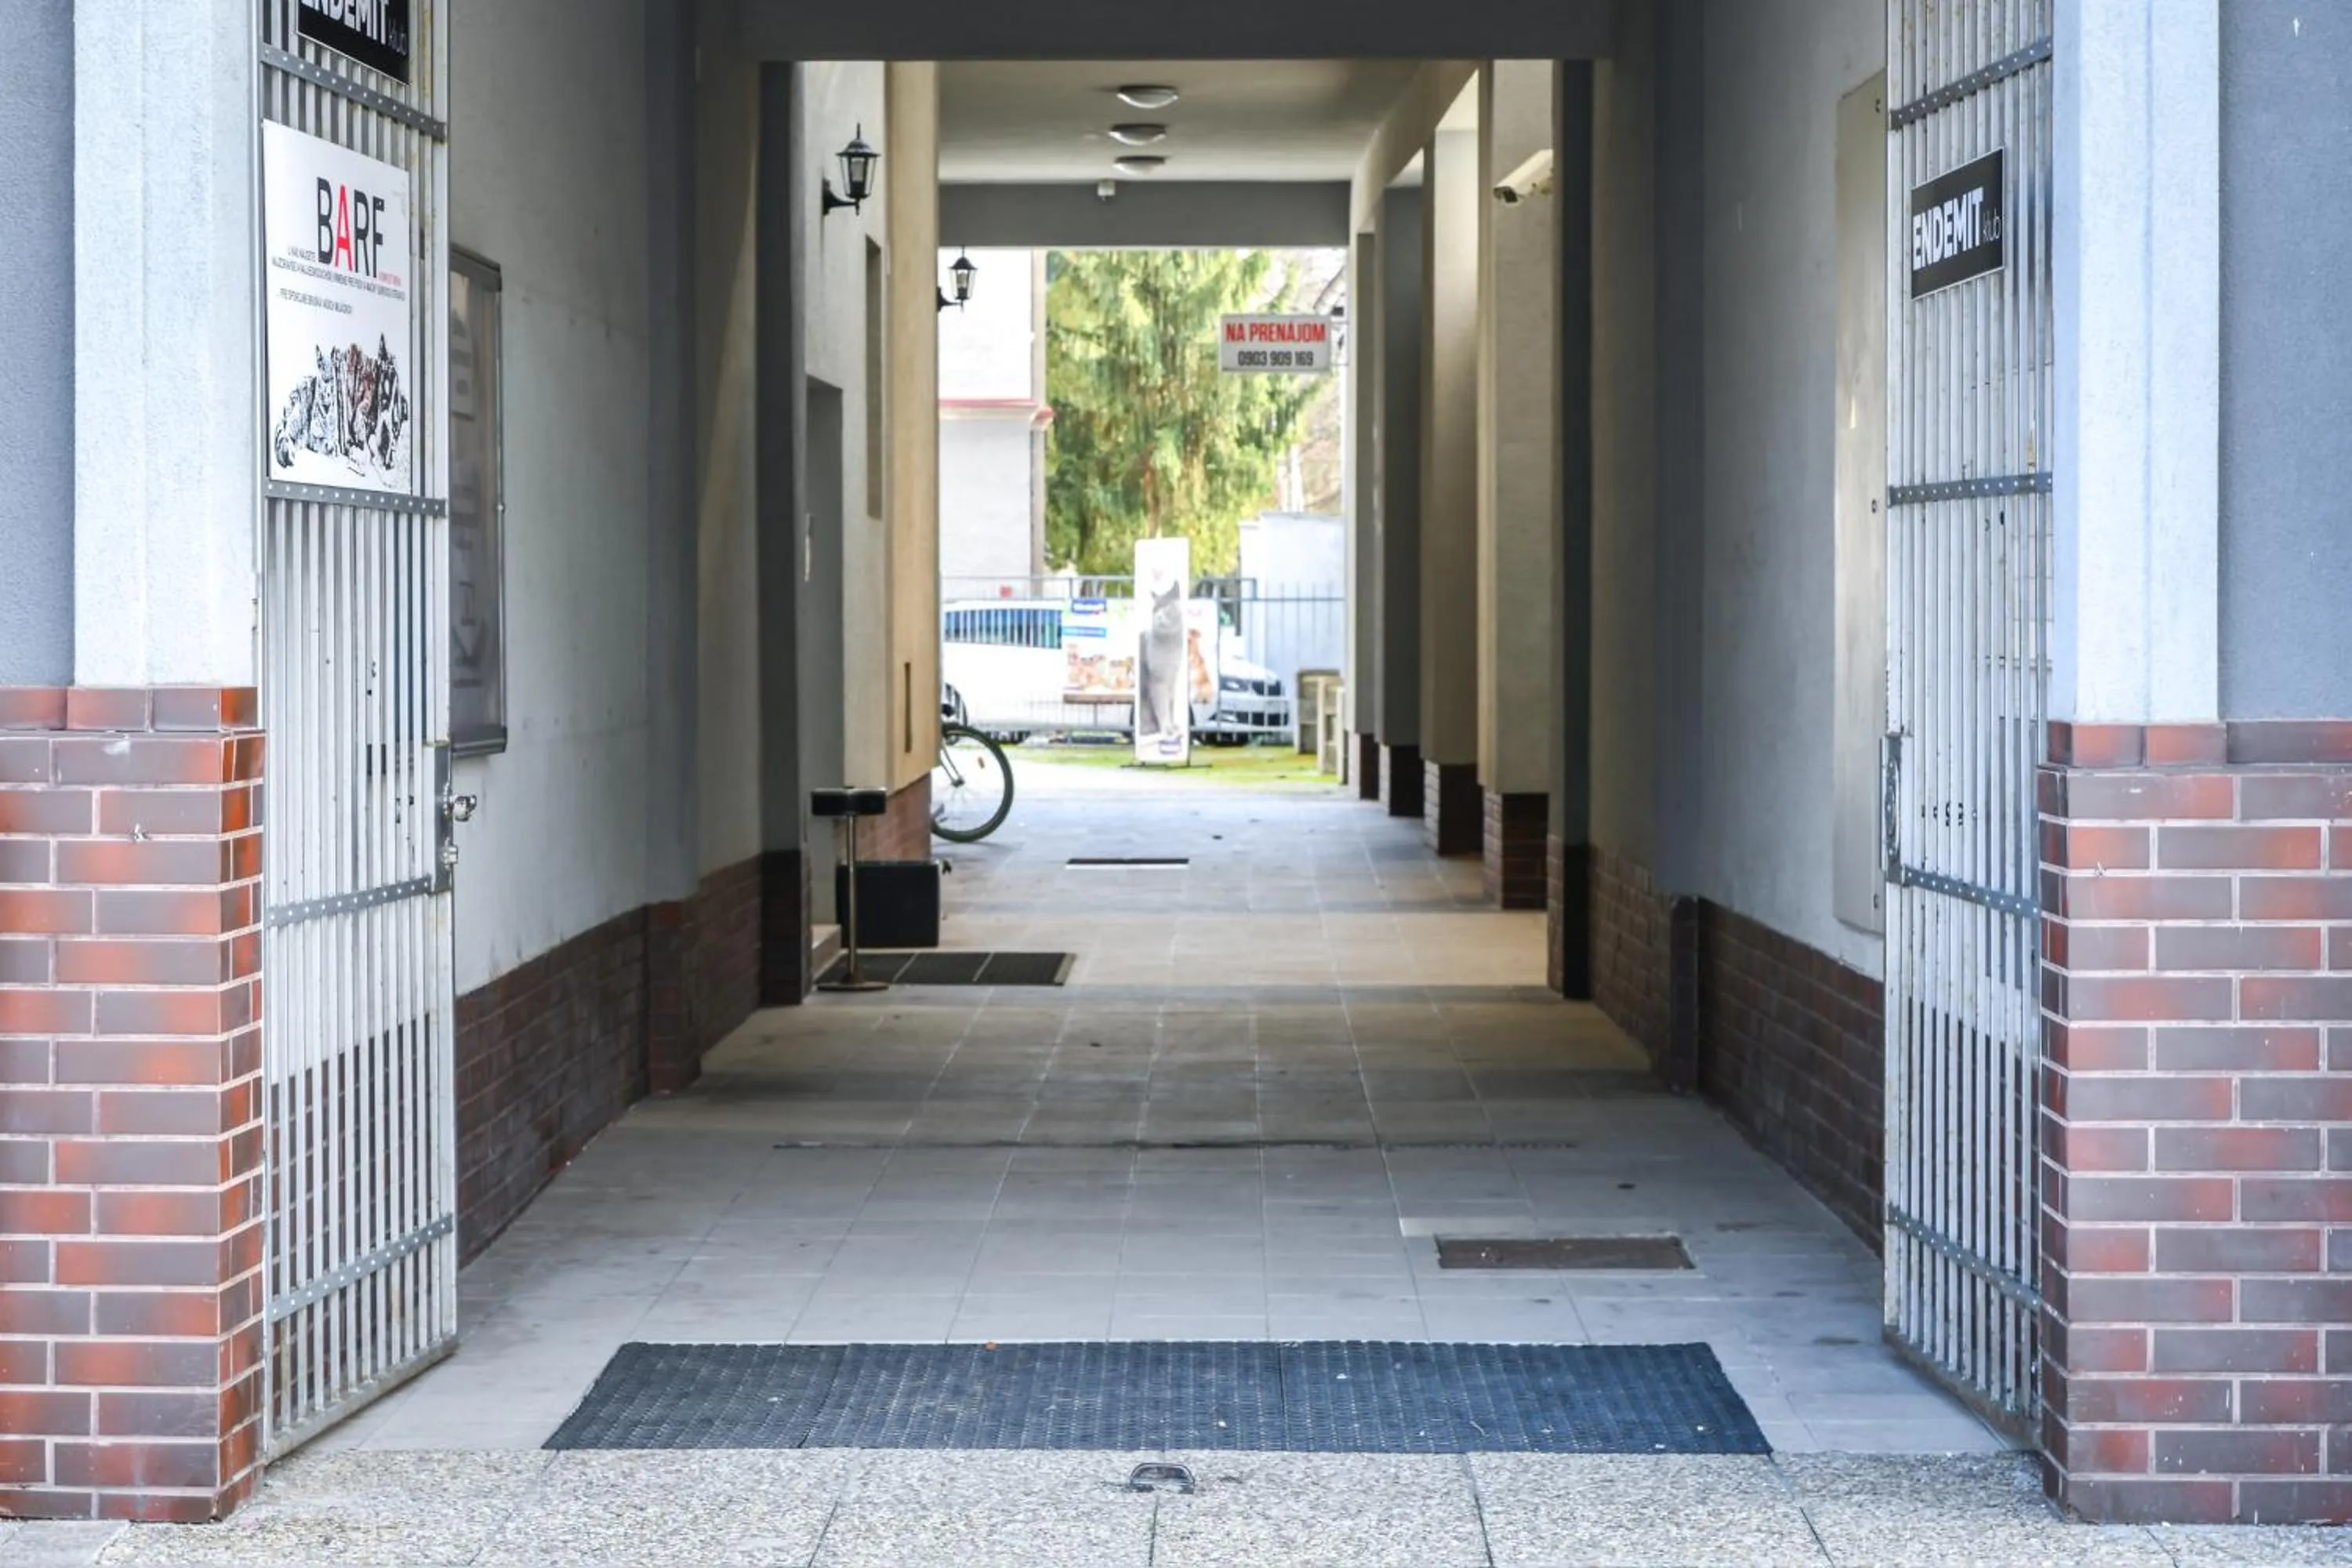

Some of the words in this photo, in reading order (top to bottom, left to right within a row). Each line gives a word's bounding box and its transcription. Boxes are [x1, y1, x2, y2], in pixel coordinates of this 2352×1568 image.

[317, 176, 385, 278] BARF
[1913, 187, 1984, 271] ENDEMIT
[1225, 322, 1245, 343] NA
[1238, 350, 1267, 366] 0903
[1270, 350, 1292, 366] 909
